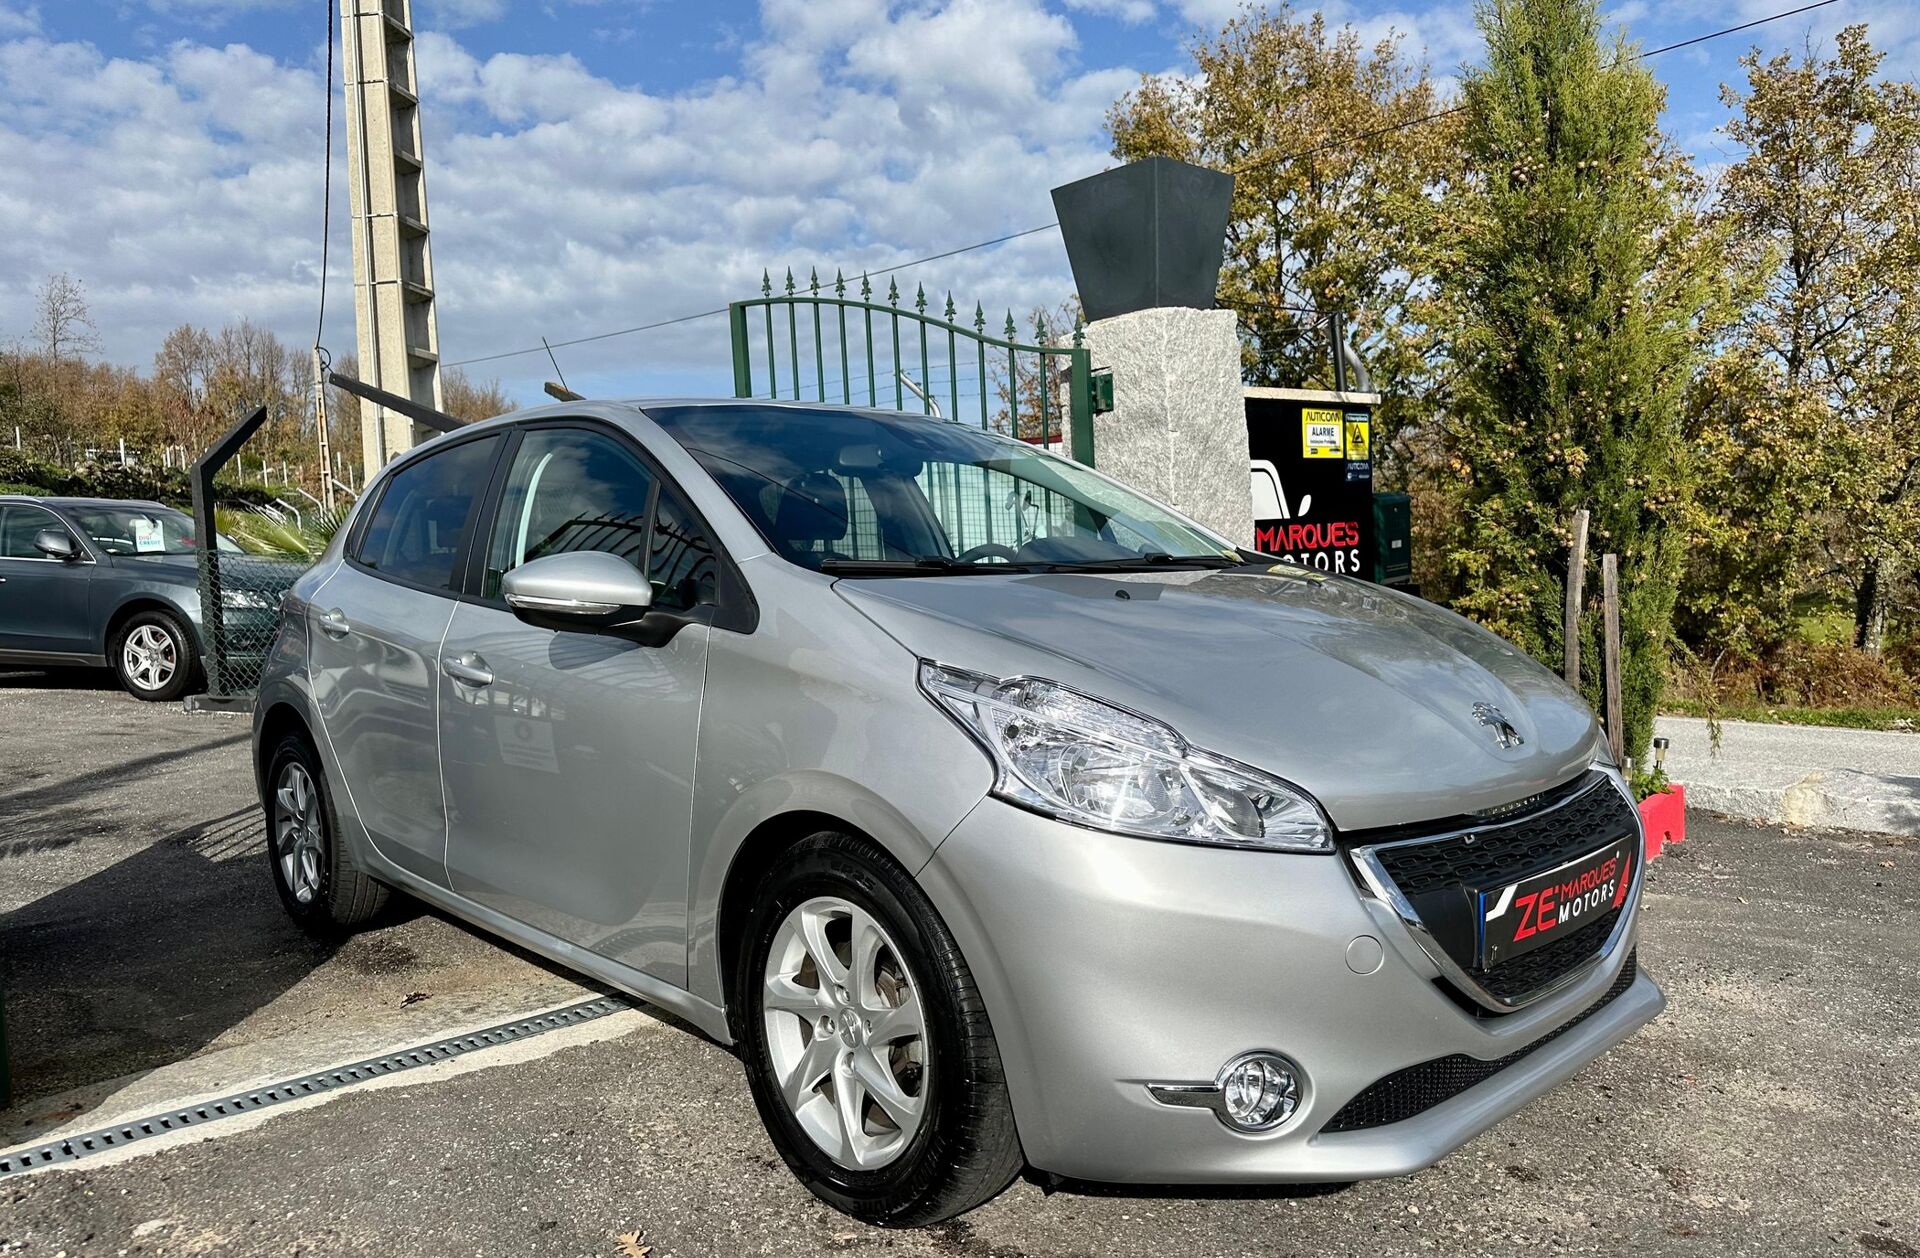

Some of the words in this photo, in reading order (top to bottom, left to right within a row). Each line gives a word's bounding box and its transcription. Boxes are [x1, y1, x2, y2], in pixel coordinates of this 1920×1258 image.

[1312, 427, 1335, 437] ALARME
[1256, 521, 1360, 553] MARQUES
[1282, 548, 1361, 574] TORS
[1560, 857, 1617, 902] MARQUES
[1558, 879, 1615, 924] MOTORS
